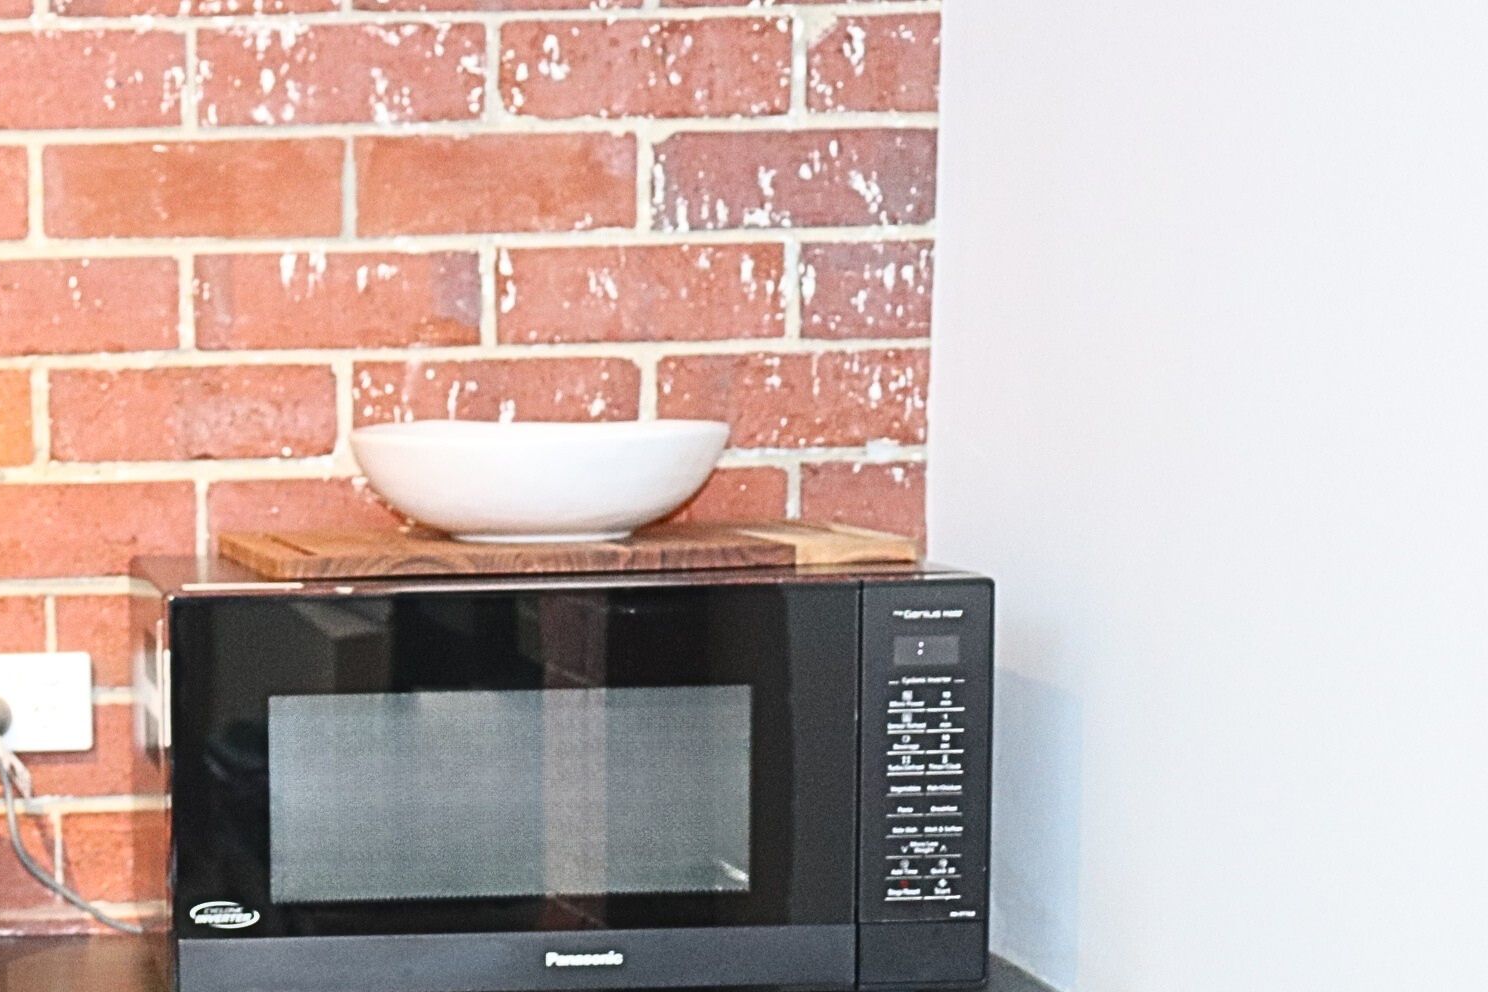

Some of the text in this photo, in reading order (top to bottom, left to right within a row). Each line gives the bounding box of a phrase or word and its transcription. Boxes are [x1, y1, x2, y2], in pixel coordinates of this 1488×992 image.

[903, 609, 941, 620] Genius
[194, 912, 252, 925] INVERTER
[545, 950, 624, 968] Panasonic
